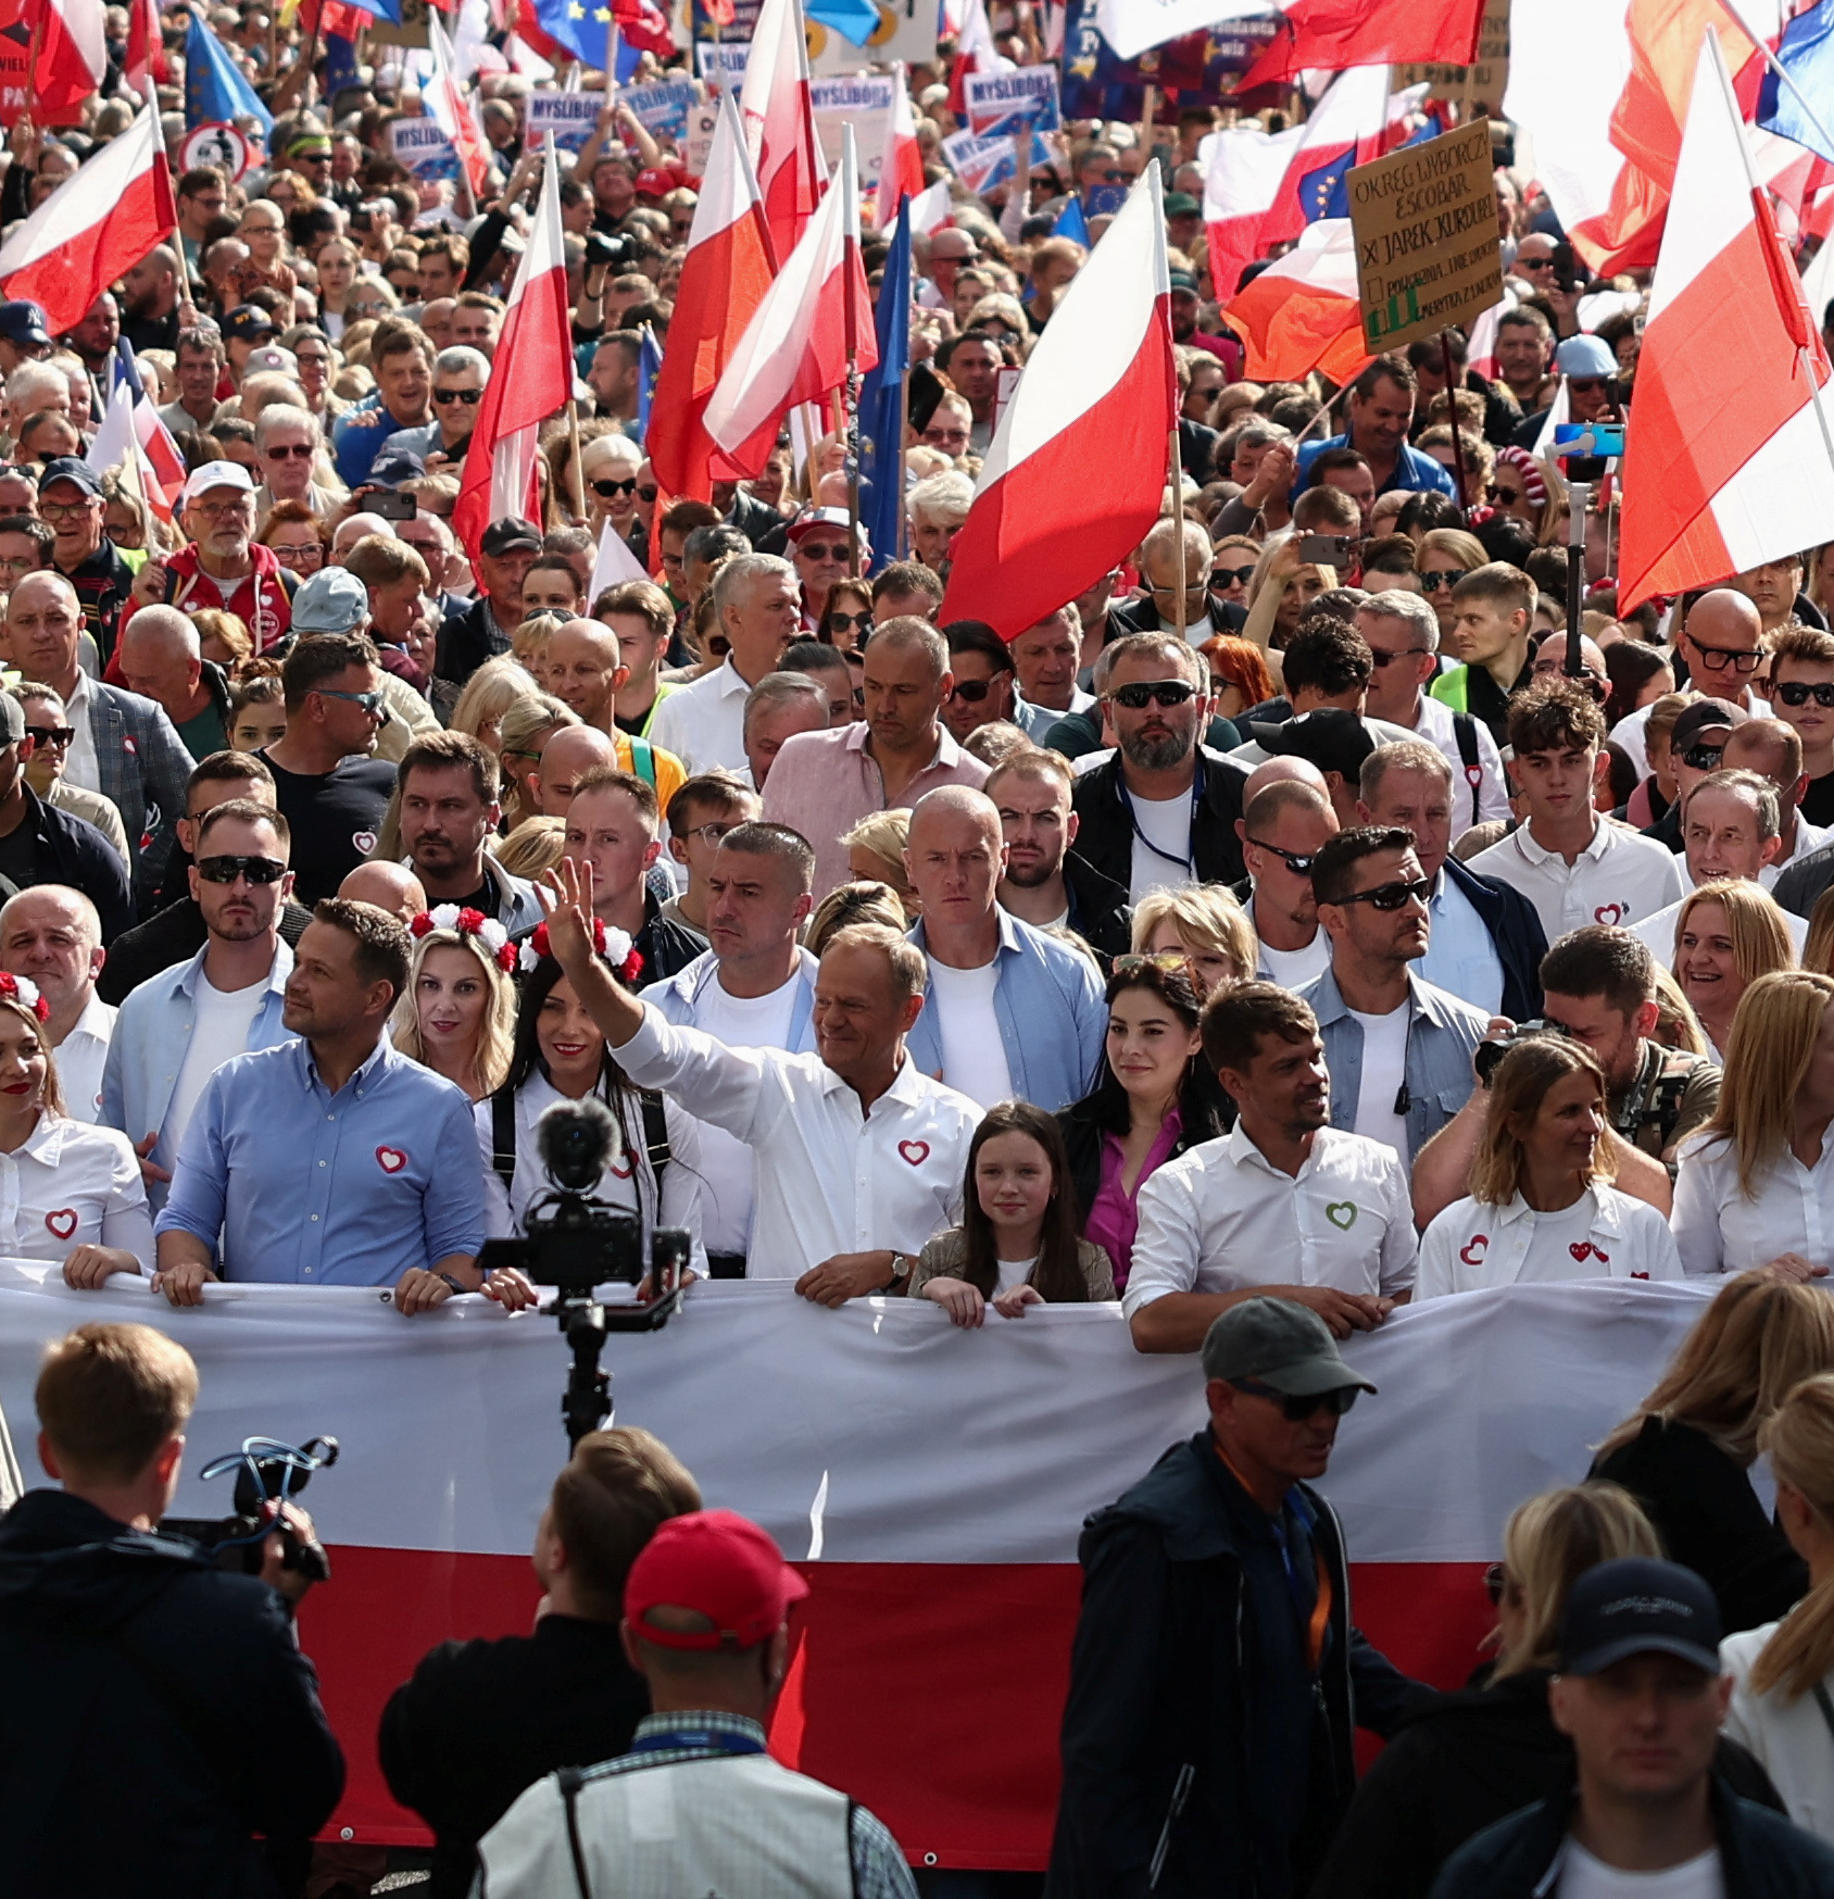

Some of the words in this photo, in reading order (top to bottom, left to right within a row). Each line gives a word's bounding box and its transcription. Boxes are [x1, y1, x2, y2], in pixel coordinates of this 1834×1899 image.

[1355, 163, 1415, 204] OKRĘG
[1417, 132, 1490, 182] WYBORCZY
[1396, 172, 1472, 219] ESCOBAR
[1380, 218, 1433, 265] JAREK
